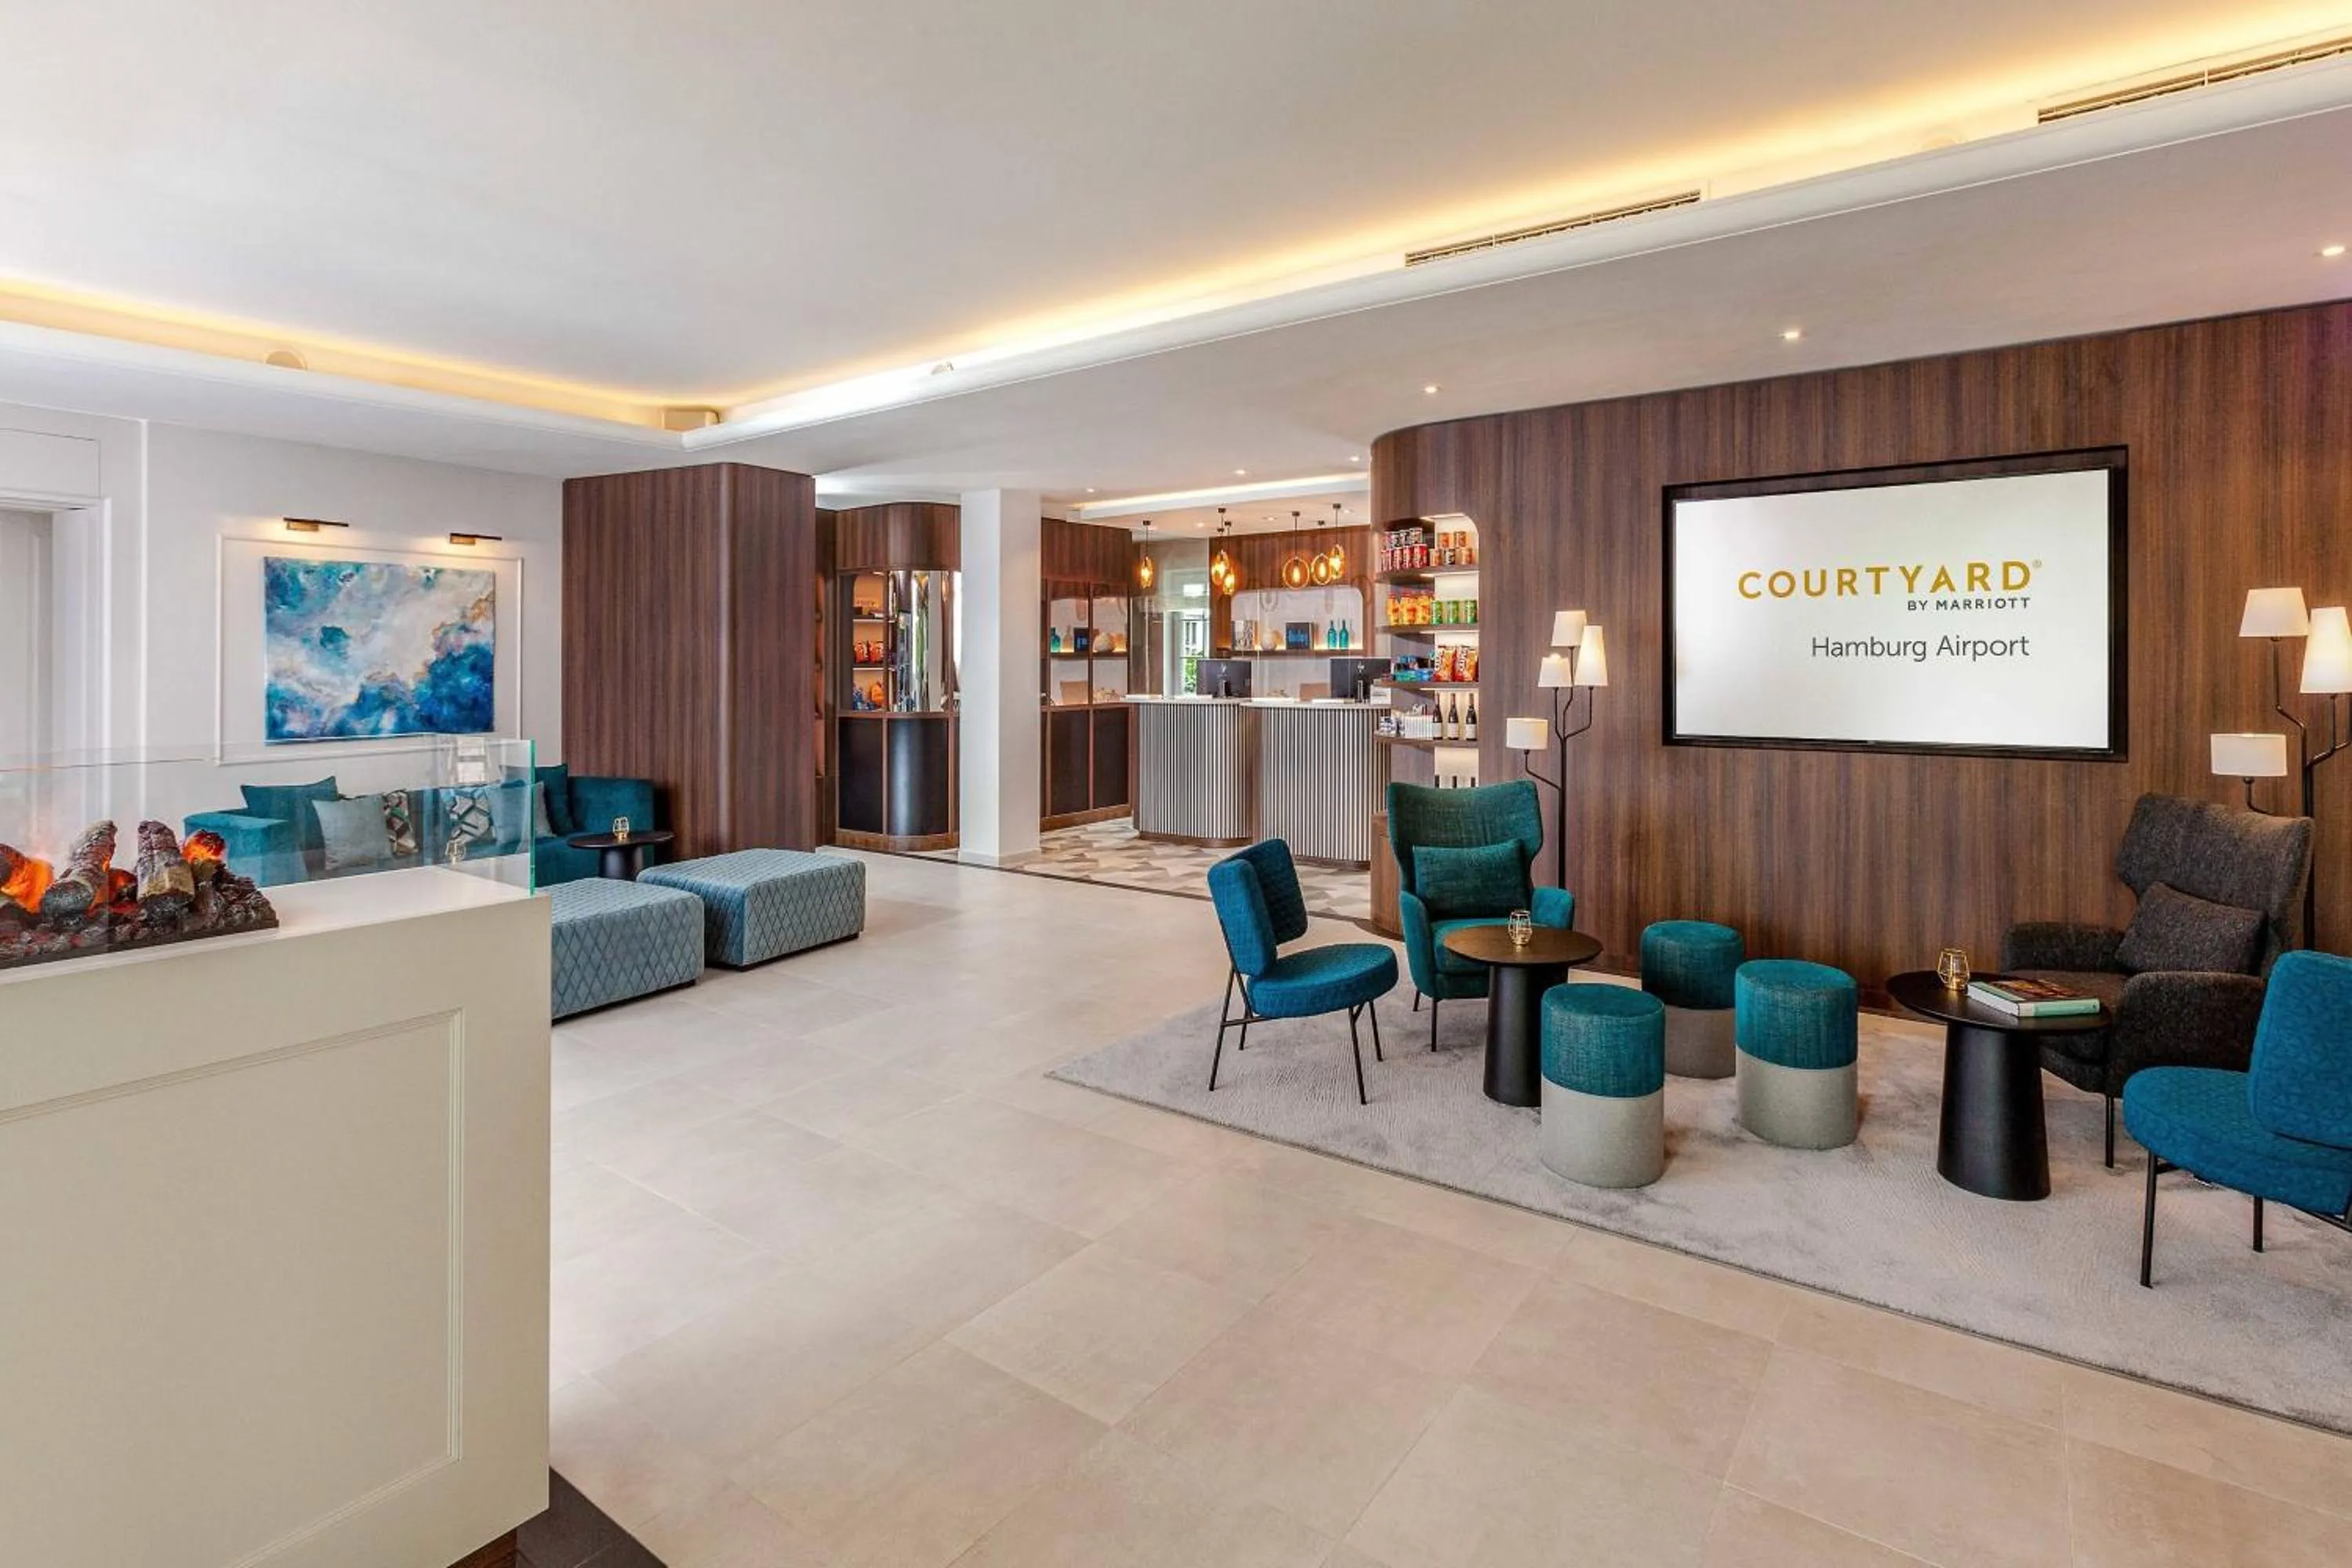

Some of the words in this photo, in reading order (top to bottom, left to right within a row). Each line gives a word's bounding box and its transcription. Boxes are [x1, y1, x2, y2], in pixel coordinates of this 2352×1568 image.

[1737, 561, 2031, 599] COURTYARD
[1907, 600, 1929, 612] BY
[1935, 596, 2031, 611] MARRIOTT
[1812, 636, 1927, 662] Hamburg
[1936, 634, 2031, 662] Airport
